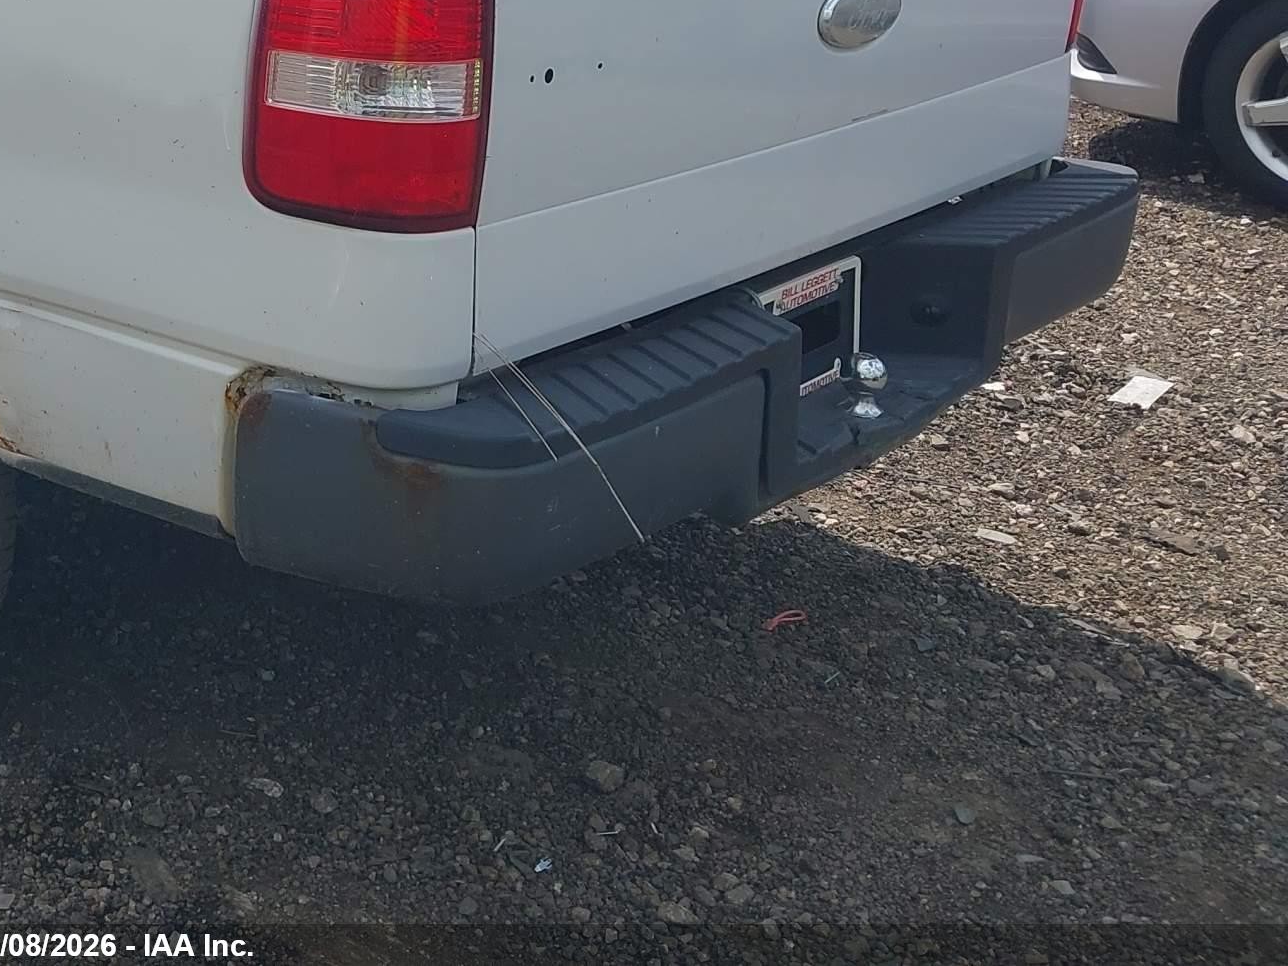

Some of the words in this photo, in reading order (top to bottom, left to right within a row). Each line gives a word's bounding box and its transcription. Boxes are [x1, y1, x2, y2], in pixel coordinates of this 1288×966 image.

[780, 281, 837, 312] AUTOMOTIVE
[781, 283, 800, 300] BILL
[801, 268, 839, 291] LEGGETT
